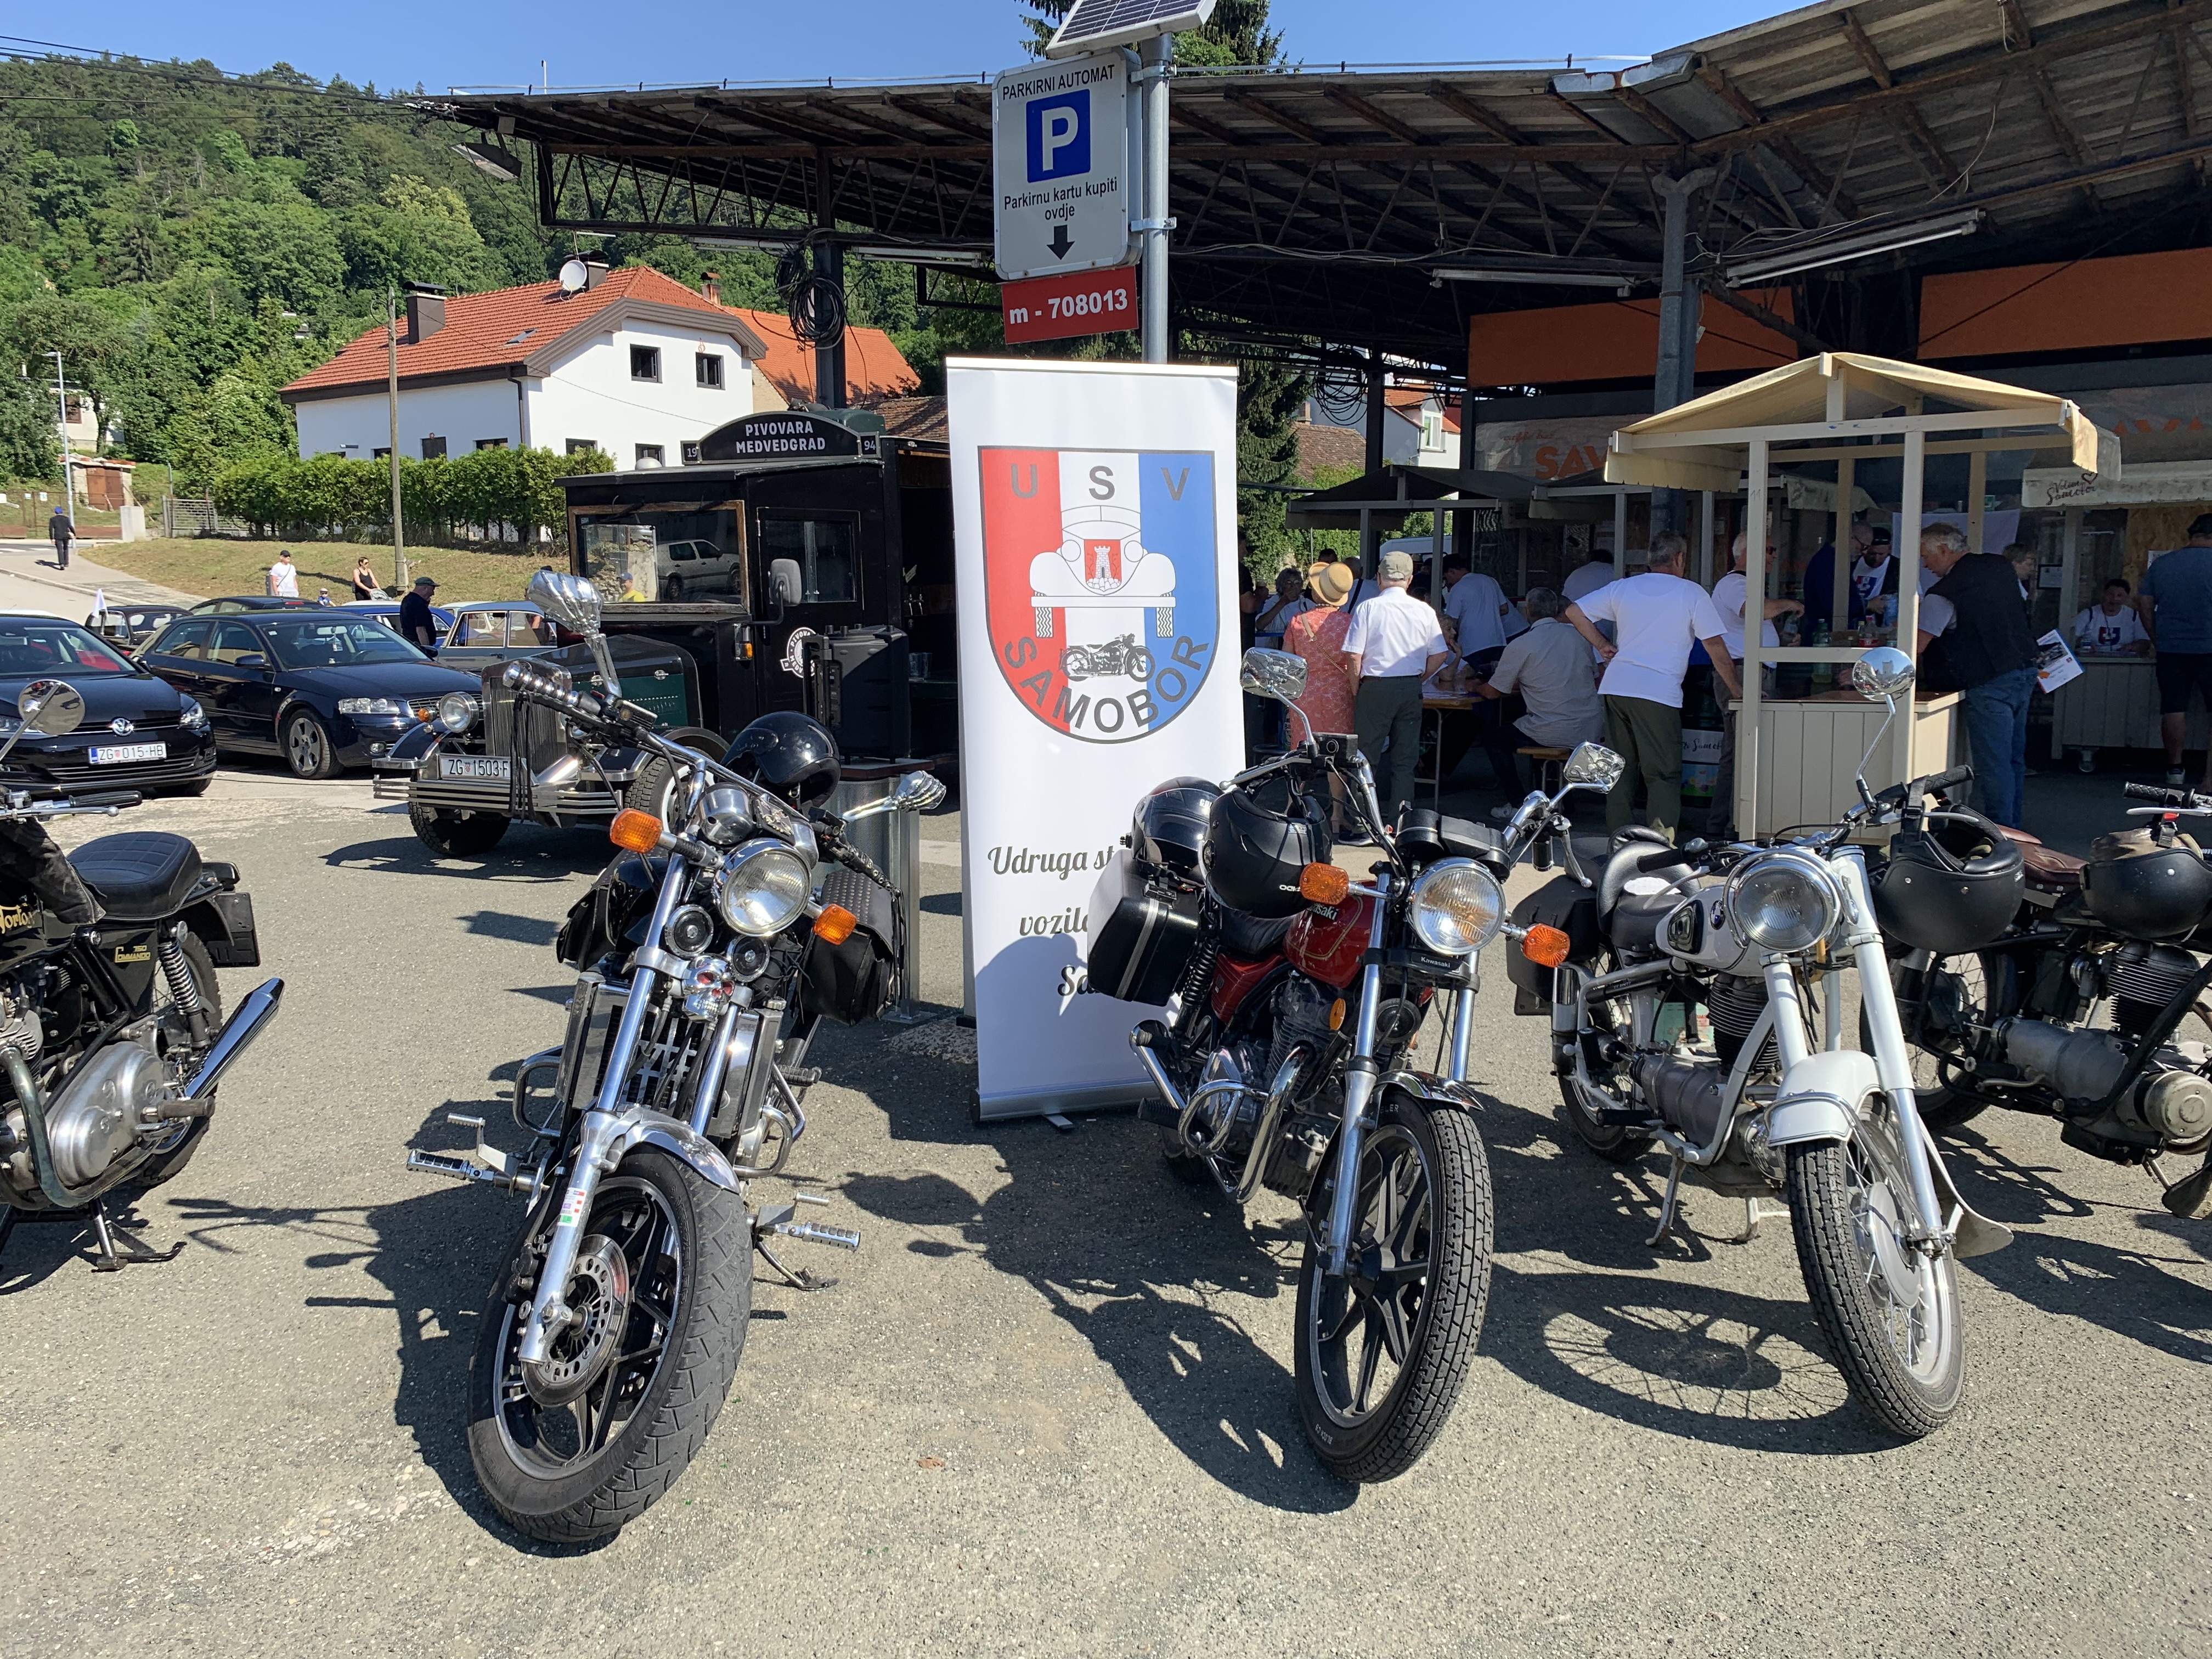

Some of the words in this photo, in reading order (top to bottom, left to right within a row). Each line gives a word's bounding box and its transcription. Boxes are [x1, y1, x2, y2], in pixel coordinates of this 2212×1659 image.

[1003, 77, 1055, 100] PARKIRNI
[1058, 64, 1115, 90] AUTOMAT
[1042, 106, 1079, 172] P
[1005, 190, 1049, 210] Parkirnu
[1053, 182, 1082, 201] kartu
[1085, 176, 1118, 198] kupiti
[1045, 204, 1075, 222] ovdje
[1009, 307, 1029, 325] m
[1047, 288, 1128, 319] 708013
[745, 420, 814, 437] PIVOVARA
[686, 448, 697, 458] 19
[736, 437, 826, 454] MEDVEDGRAD
[864, 439, 876, 451] 94
[1535, 444, 1606, 480] SAV
[1011, 464, 1039, 499] U
[1088, 465, 1116, 500] S
[1160, 467, 1191, 501] V
[790, 630, 811, 647] PIVOVA
[1004, 634, 1210, 734] SAMOBOR
[99, 749, 114, 760] ZG
[122, 745, 164, 759] 015-HB
[449, 759, 464, 775] ZG
[473, 760, 509, 777] 1503-F
[988, 845, 1088, 881] Udruga
[1308, 903, 1338, 921] asaki
[1420, 956, 1451, 968] Kawasaki
